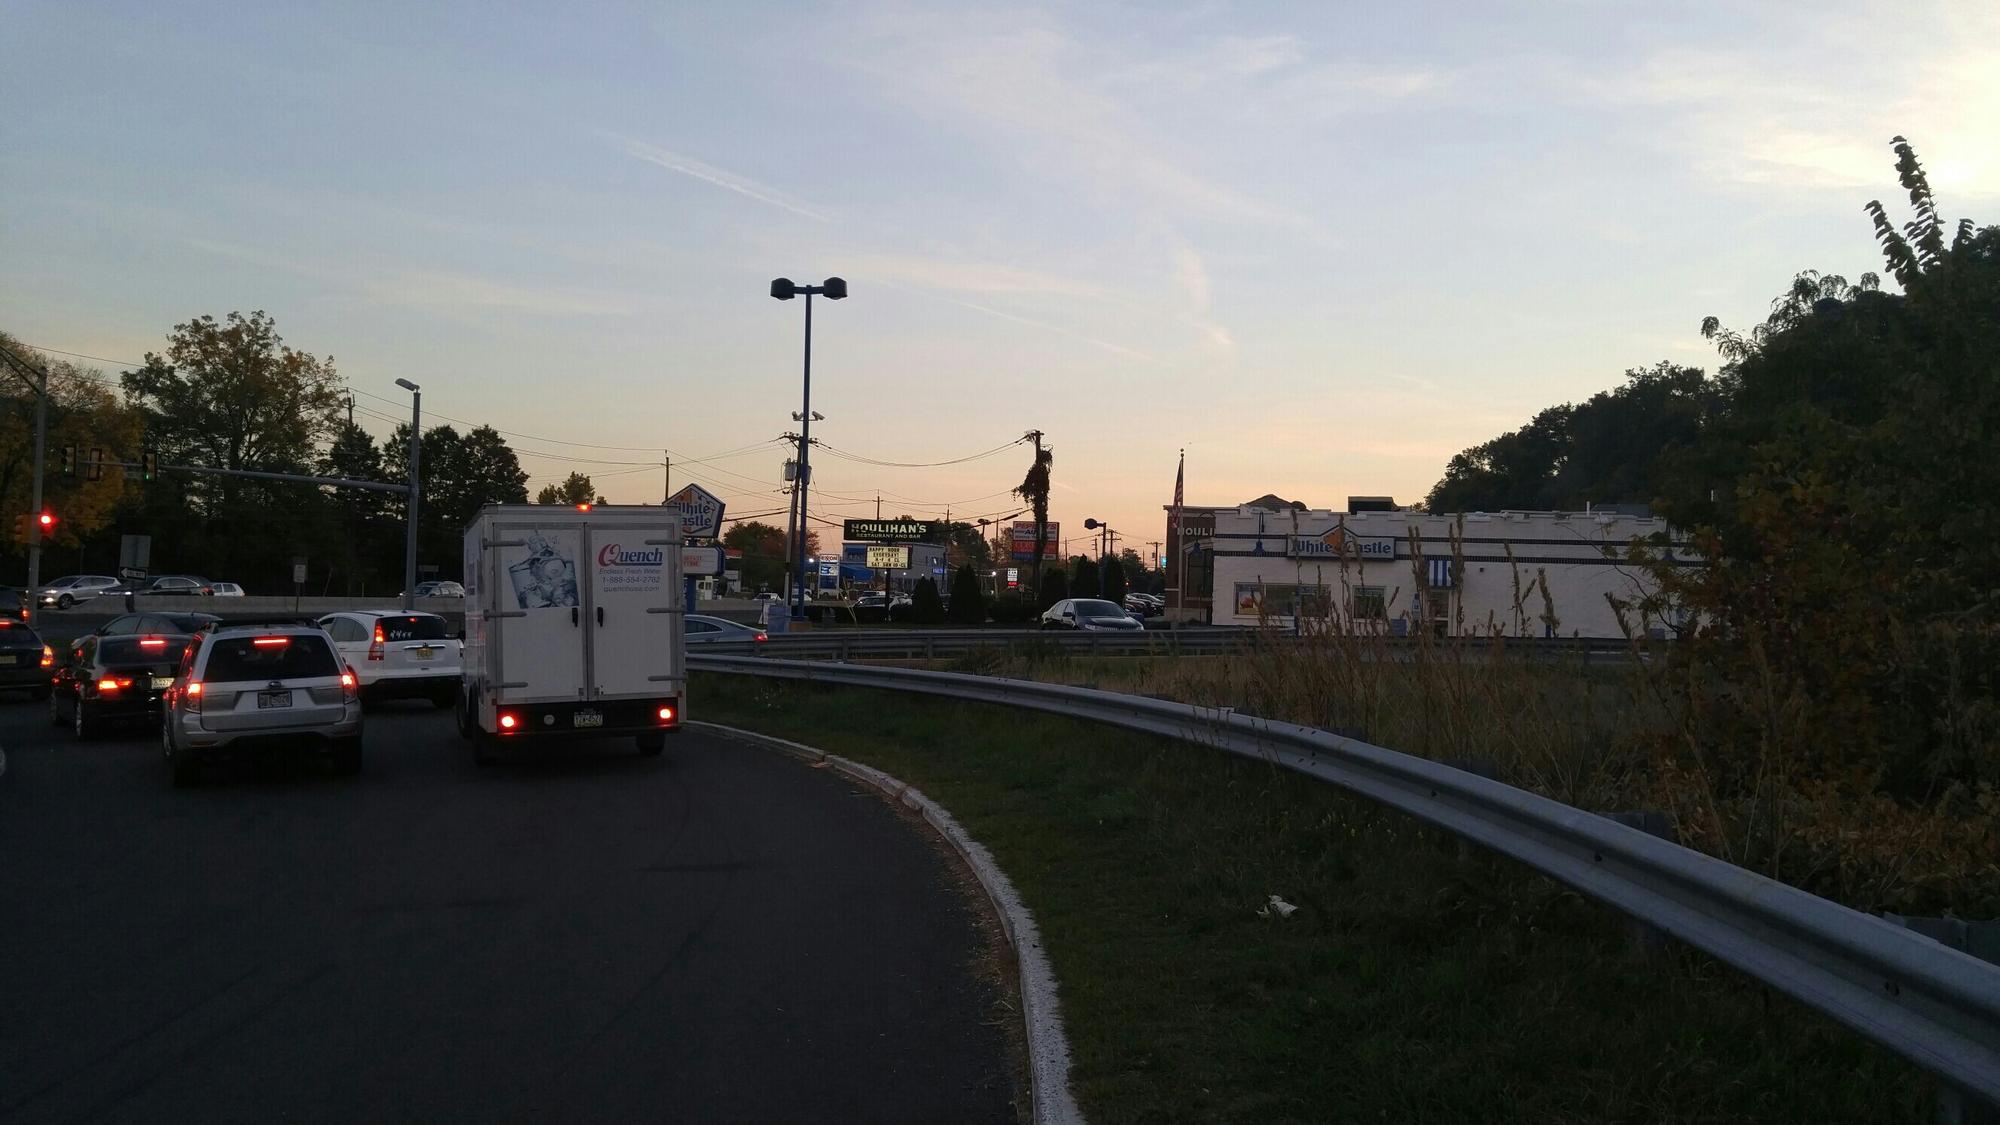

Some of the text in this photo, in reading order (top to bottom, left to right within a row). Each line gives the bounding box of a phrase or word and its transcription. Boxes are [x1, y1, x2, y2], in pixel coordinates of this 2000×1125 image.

[681, 515, 712, 527] astle
[851, 523, 927, 533] HOULIHAN'S
[1177, 527, 1216, 536] HOULI
[599, 543, 663, 567] Quench
